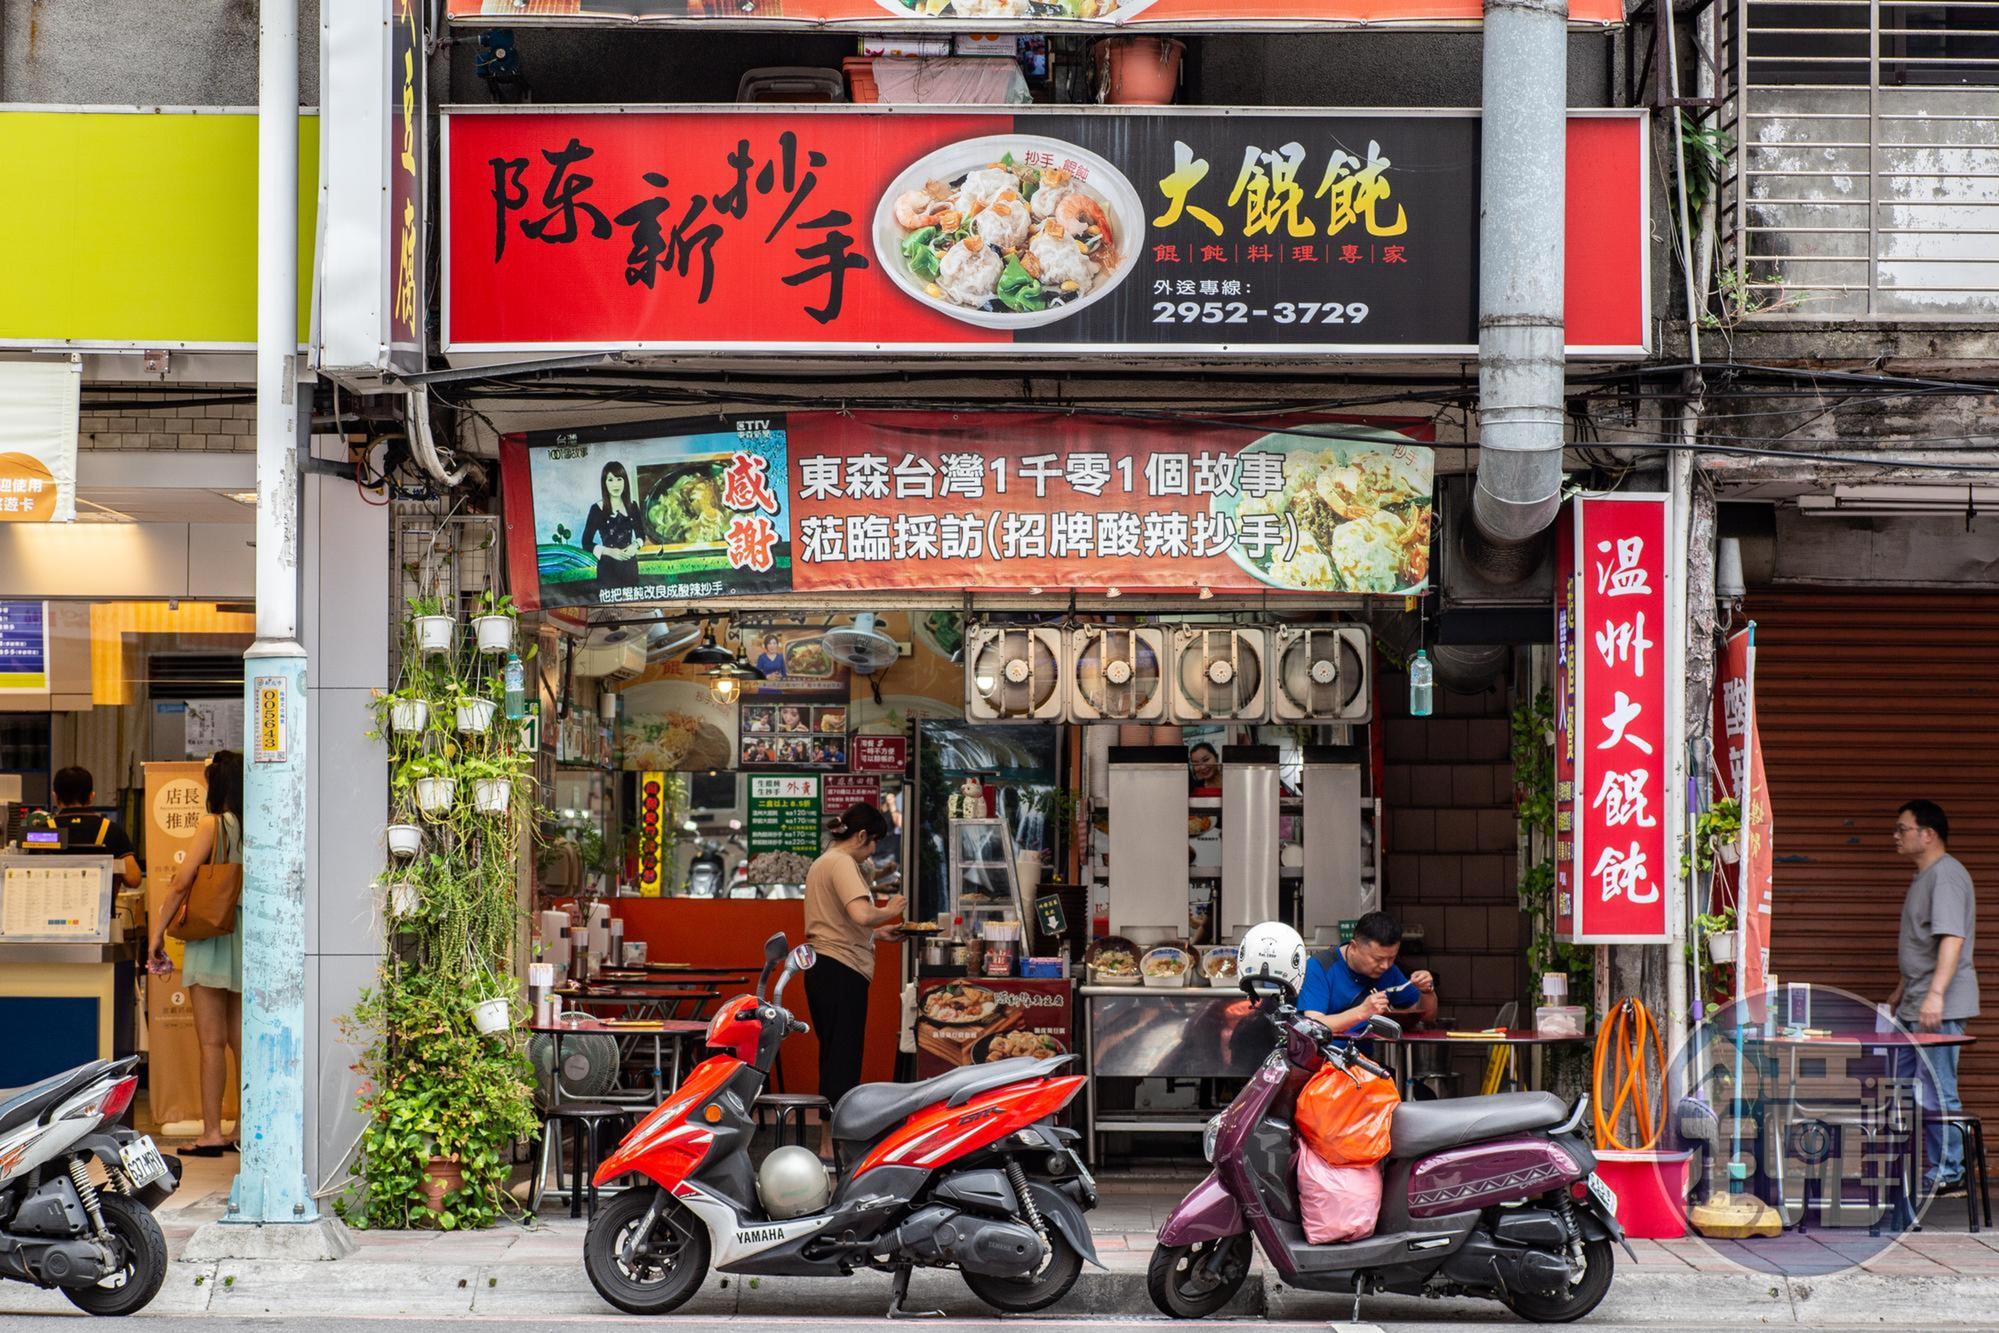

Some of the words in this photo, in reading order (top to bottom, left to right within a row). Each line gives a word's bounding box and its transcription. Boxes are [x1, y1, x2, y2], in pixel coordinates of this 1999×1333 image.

[395, 0, 417, 338] 豆腐
[1152, 139, 1408, 238] 大餛飩
[488, 131, 869, 324] 陳新抄手
[1152, 301, 1370, 325] 2952-3729
[798, 451, 1286, 501] 東森台灣1千零1個故事
[0, 497, 35, 512] 遊卡
[722, 451, 781, 573] 感謝
[799, 509, 1300, 564] 蒞臨採訪(招牌酸辣抄手)
[263, 690, 276, 748] 005643
[166, 788, 200, 805] 店長
[736, 1228, 785, 1244] YAMAHA
